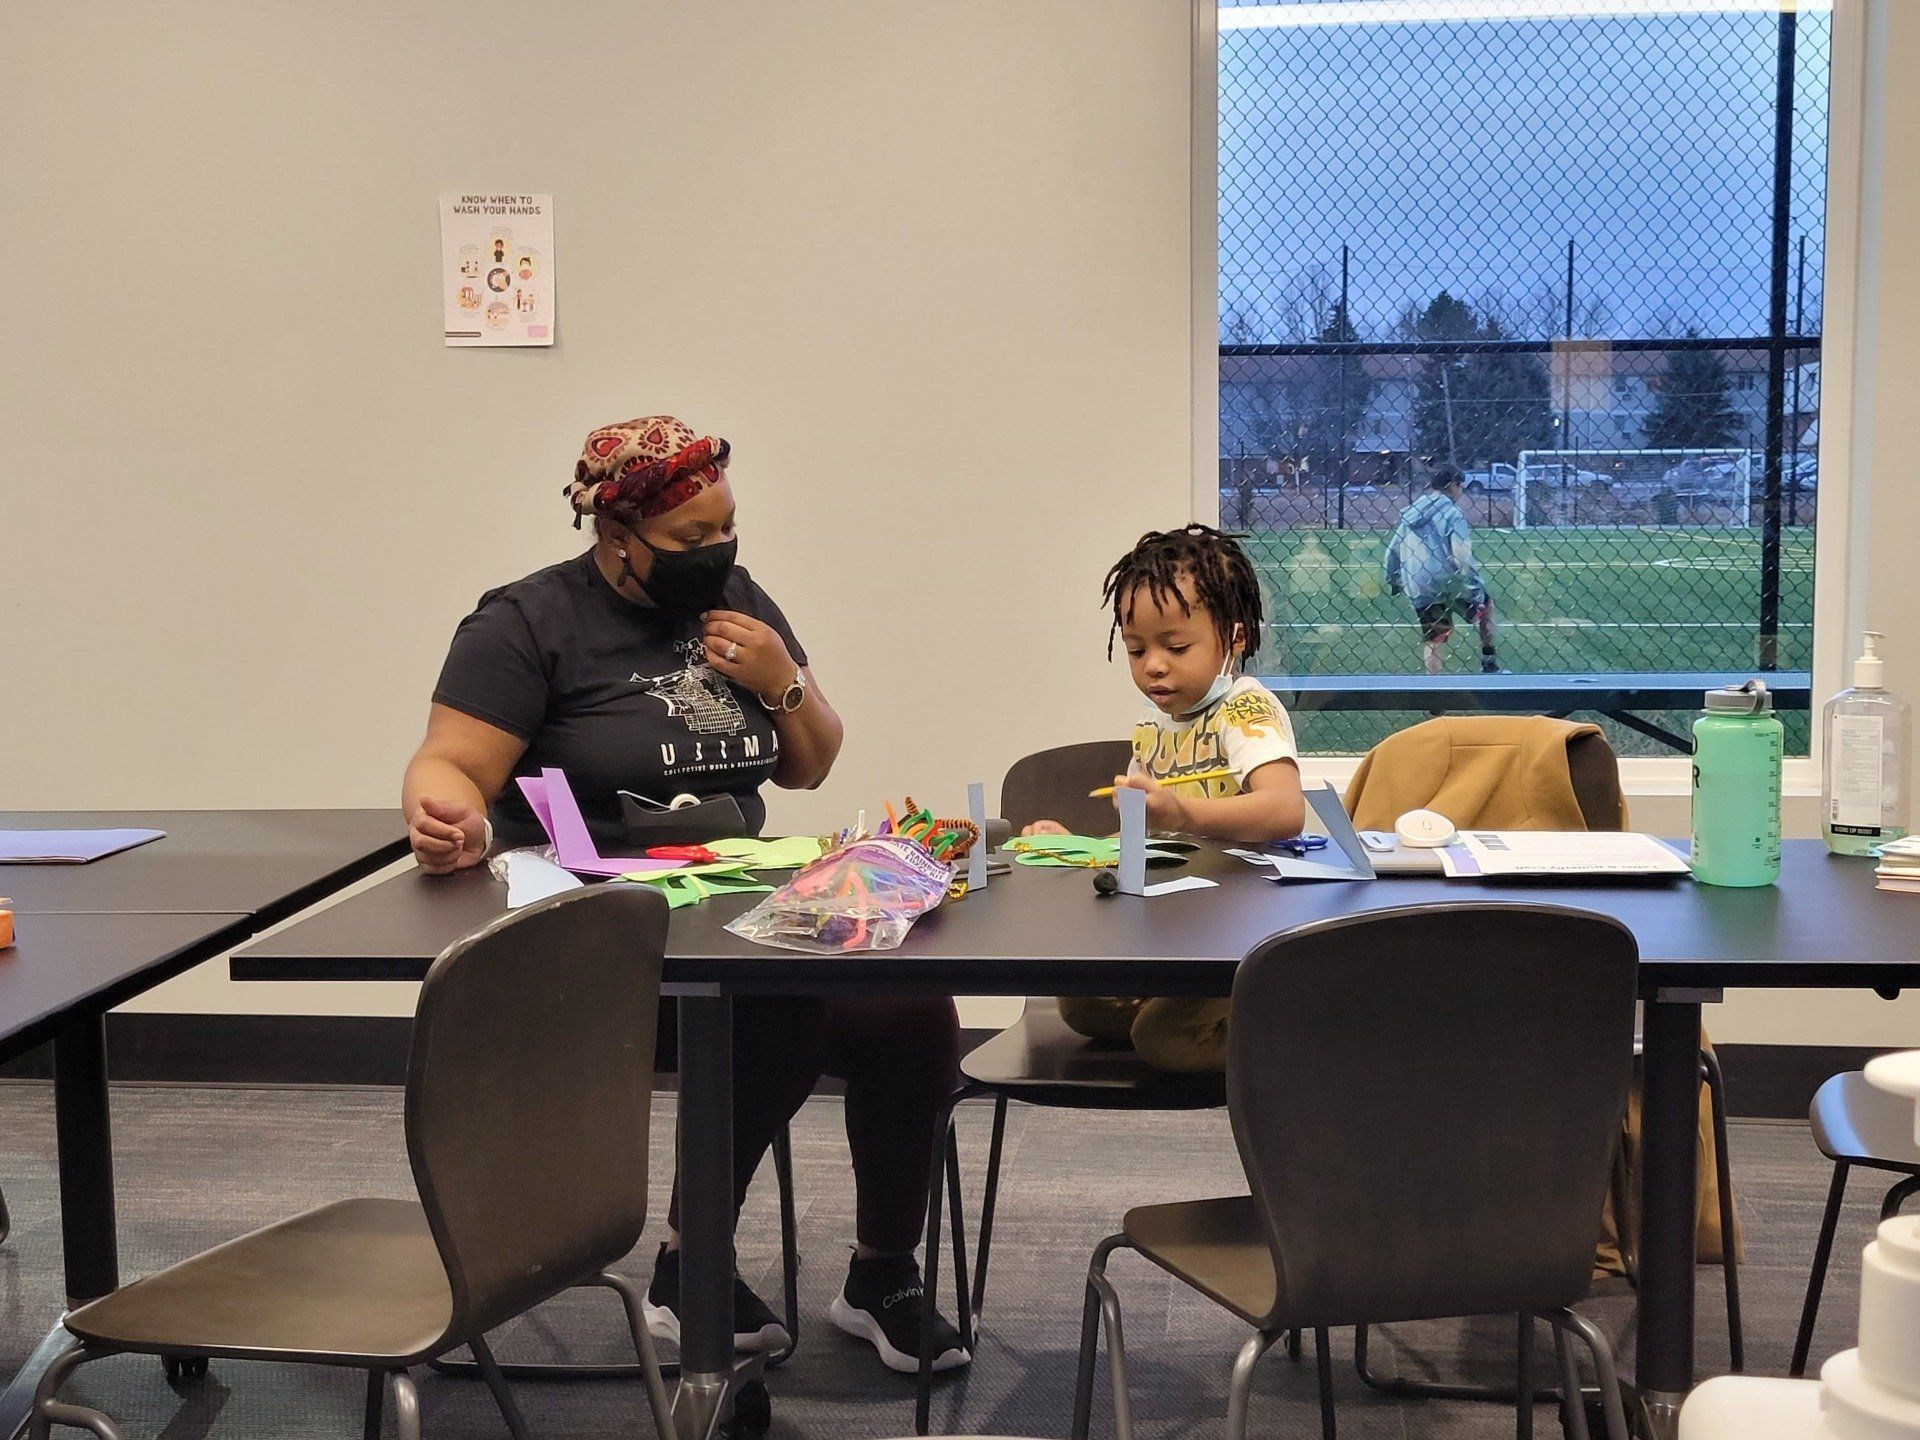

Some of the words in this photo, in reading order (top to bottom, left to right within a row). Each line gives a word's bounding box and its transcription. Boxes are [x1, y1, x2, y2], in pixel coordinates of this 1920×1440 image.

[461, 195, 487, 204] KNOW
[490, 195, 517, 205] WHEN
[520, 196, 533, 205] TO
[453, 206, 480, 214] WASH
[482, 206, 507, 214] YOUR
[509, 206, 541, 215] HANDS
[882, 1286, 919, 1308] Calvin
